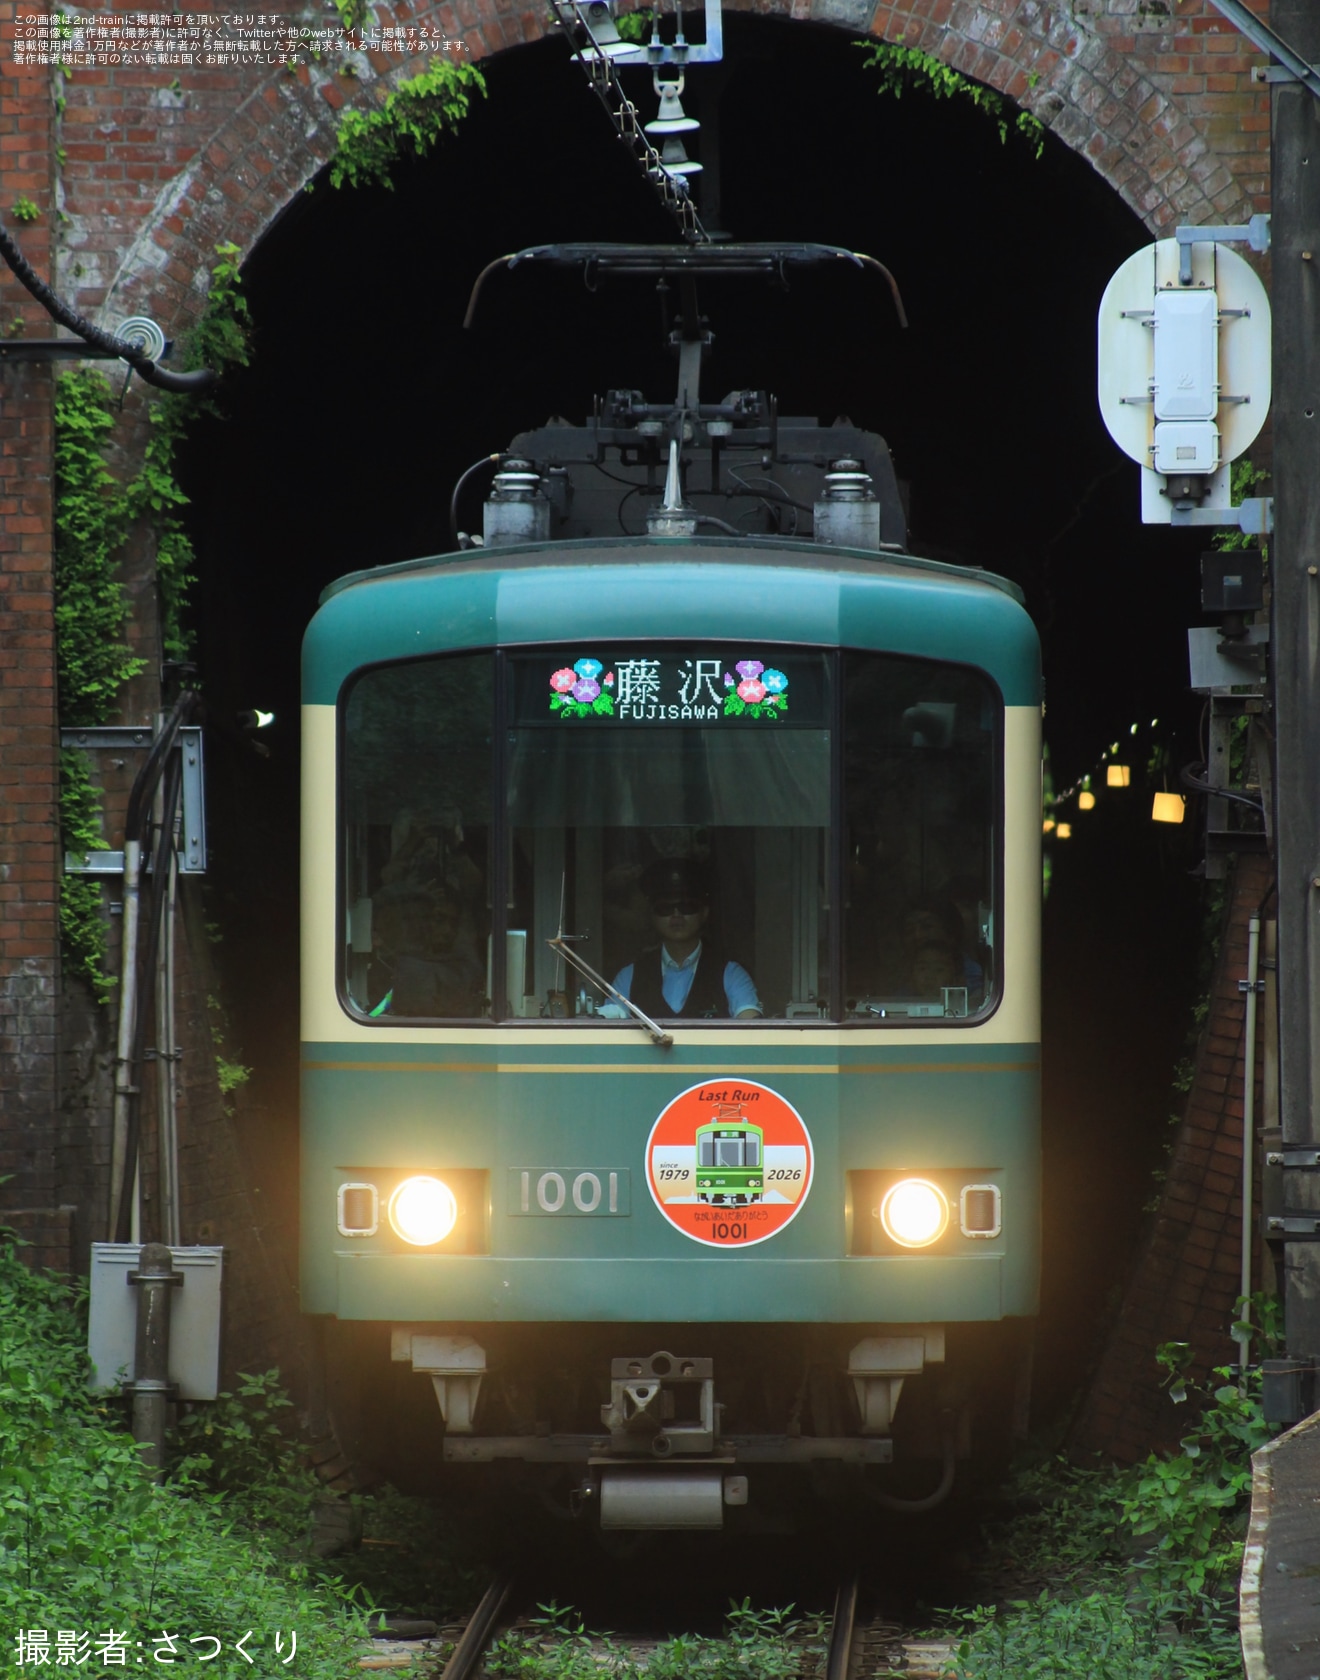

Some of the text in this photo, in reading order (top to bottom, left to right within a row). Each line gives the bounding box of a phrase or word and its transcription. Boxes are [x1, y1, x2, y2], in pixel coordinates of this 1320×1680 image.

[619, 705, 719, 719] FUJISAWA
[698, 1090, 760, 1102] Last Run
[659, 1169, 690, 1181] 1979
[767, 1169, 802, 1181] 2026
[521, 1171, 618, 1213] 1001
[712, 1222, 747, 1239] 1001
